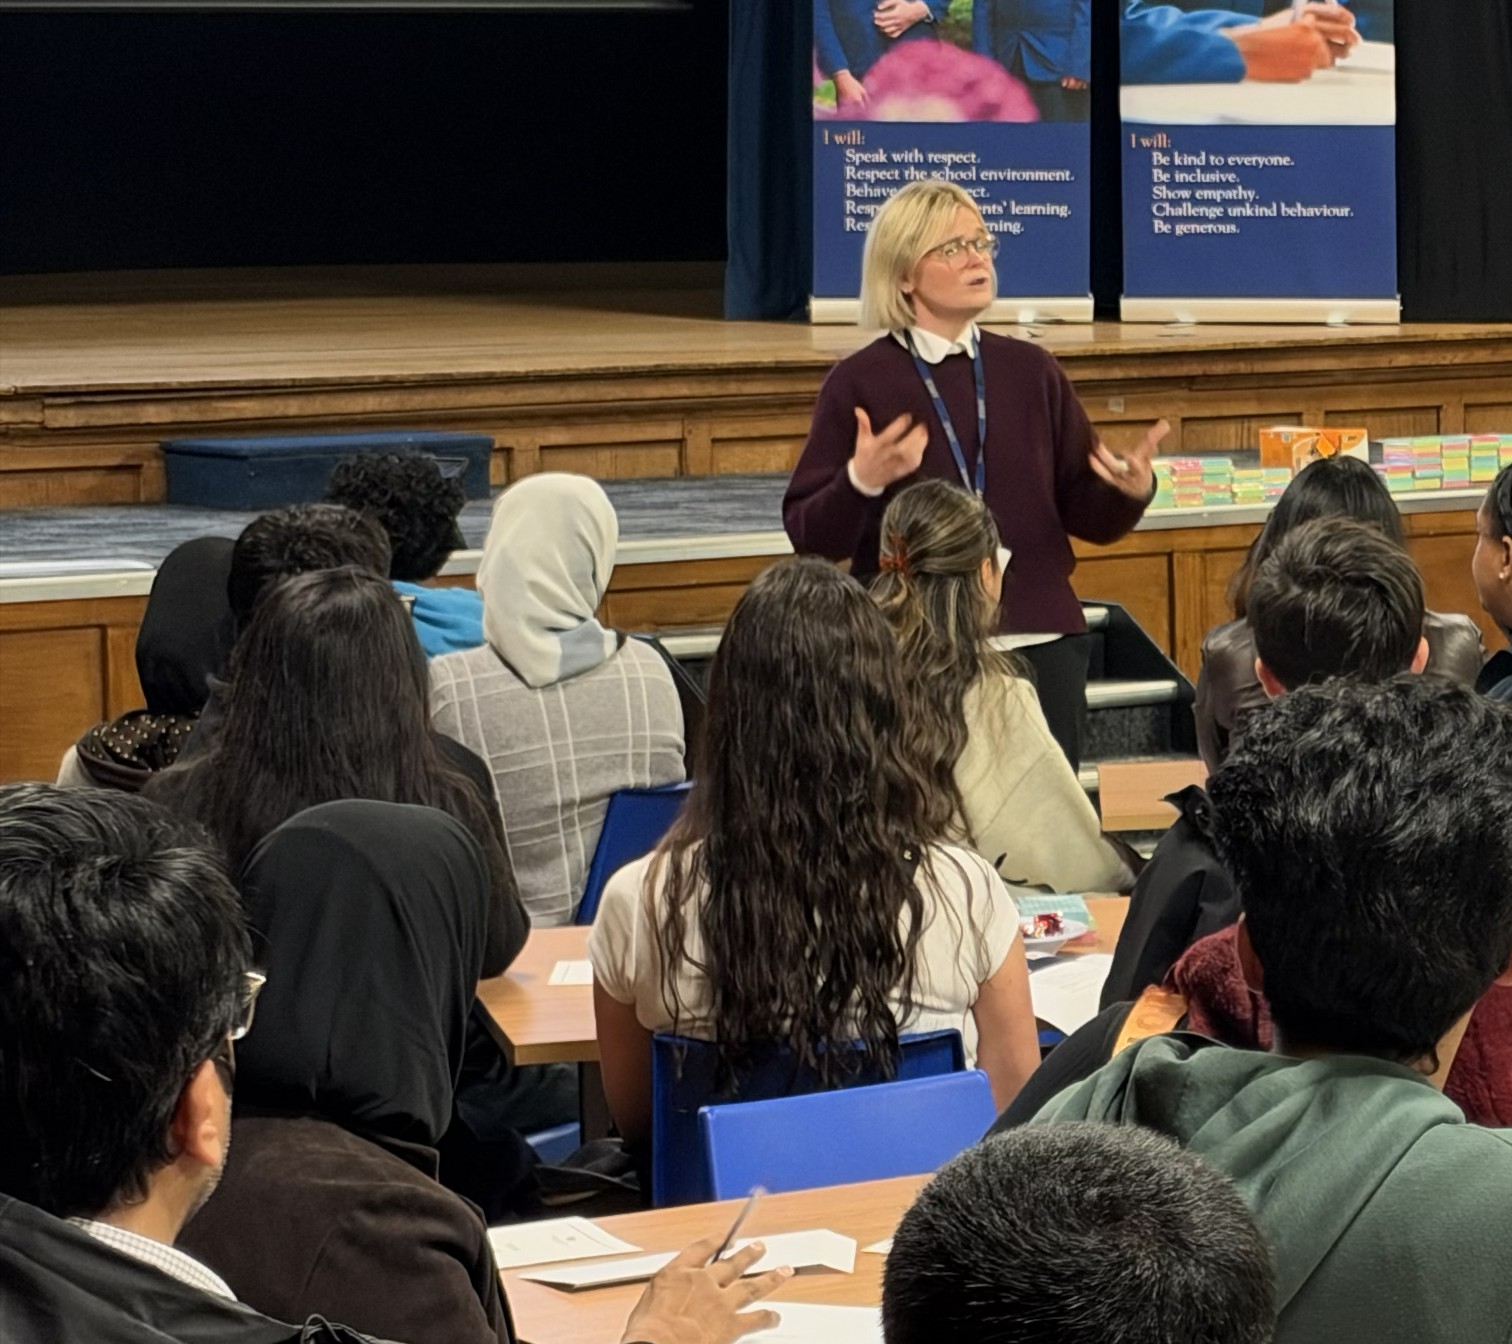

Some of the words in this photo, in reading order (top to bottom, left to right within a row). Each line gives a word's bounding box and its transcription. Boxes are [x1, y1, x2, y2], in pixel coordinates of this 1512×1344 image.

[834, 129, 865, 145] will:
[1140, 133, 1171, 148] will:
[845, 148, 888, 165] Speak
[892, 148, 924, 163] with
[927, 152, 980, 167] respect.
[1153, 152, 1171, 165] Be
[1174, 151, 1206, 166] kind
[1209, 154, 1224, 165] to
[1228, 156, 1294, 168] everyone.
[845, 166, 900, 183] Respect
[904, 165, 928, 180] the
[931, 165, 976, 181] school
[980, 168, 1075, 182] environment.
[1153, 169, 1171, 182] Be
[1175, 169, 1240, 183] inclusive.
[965, 187, 990, 198] ect.
[1152, 186, 1192, 199] Show
[1196, 186, 1259, 202] empathy.
[846, 200, 880, 218] Resp
[1010, 200, 1071, 218] learning.
[1152, 203, 1224, 219] Challenge
[1228, 202, 1277, 217] unkind
[1281, 202, 1354, 217] behaviour.
[985, 220, 1025, 235] rning.
[1154, 220, 1171, 234] Be
[1176, 223, 1240, 236] generous.
